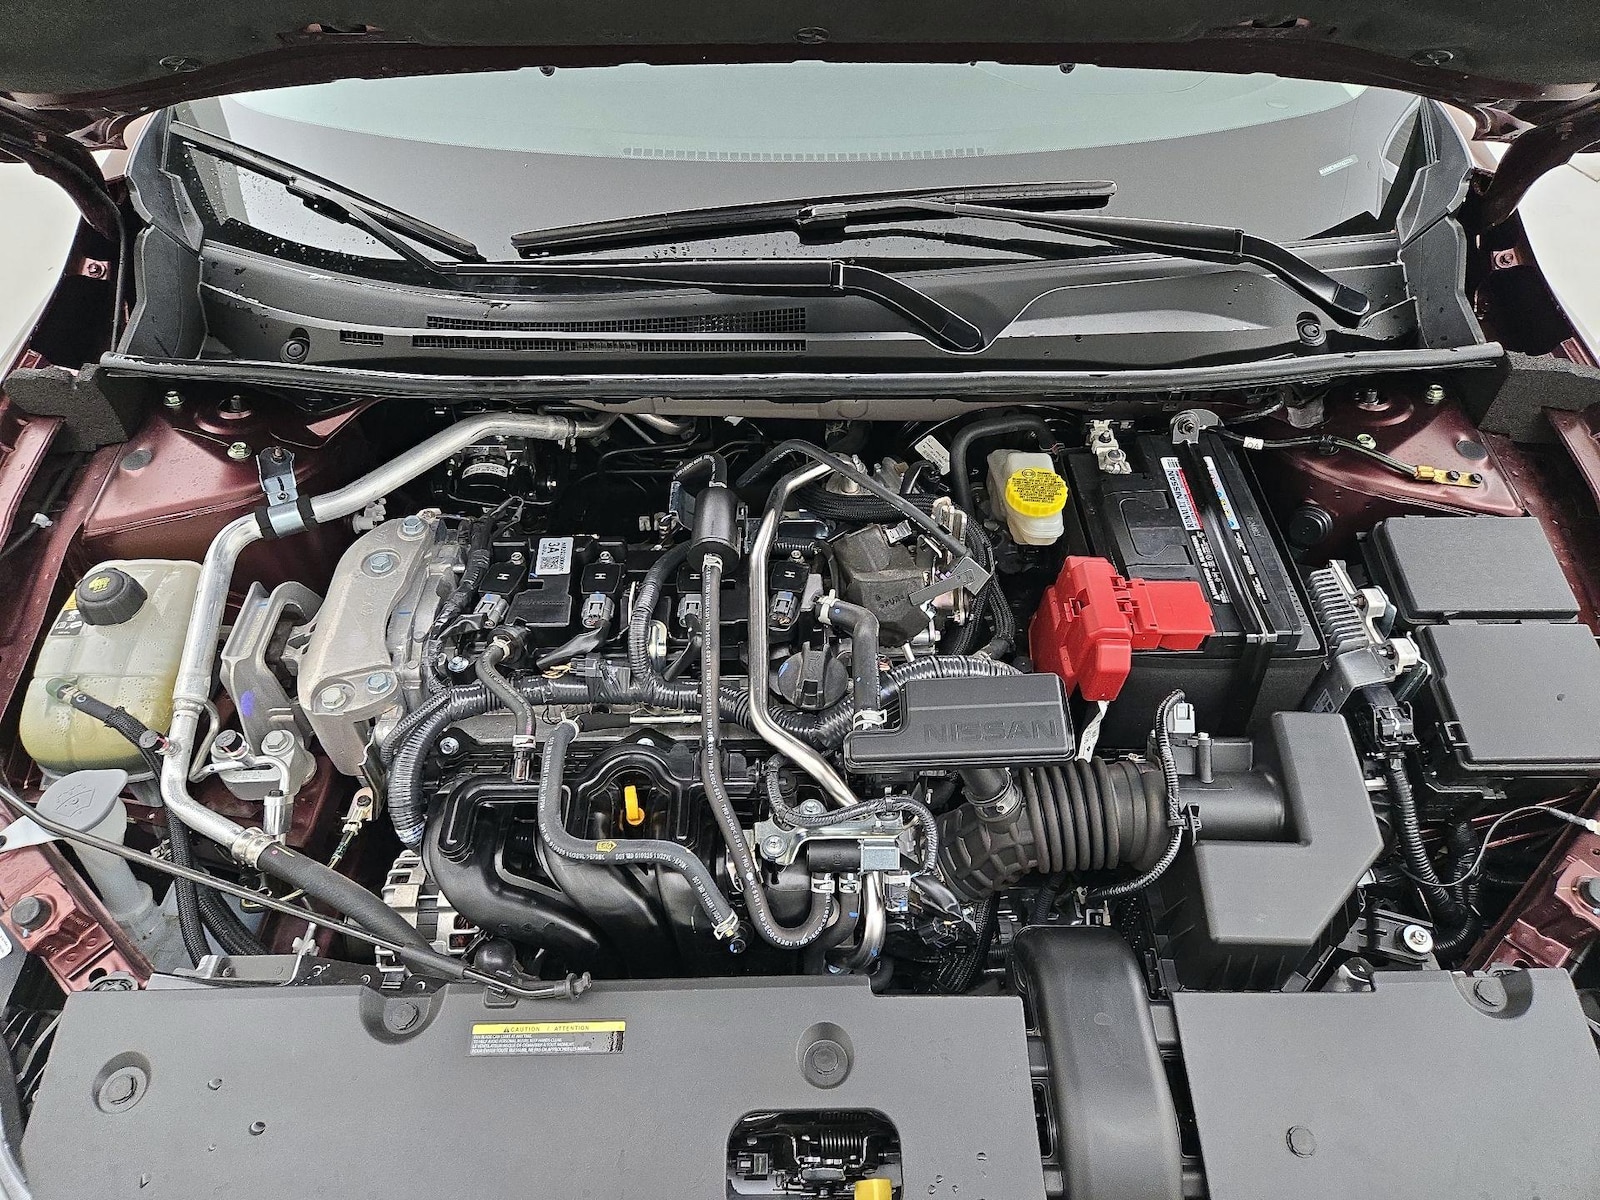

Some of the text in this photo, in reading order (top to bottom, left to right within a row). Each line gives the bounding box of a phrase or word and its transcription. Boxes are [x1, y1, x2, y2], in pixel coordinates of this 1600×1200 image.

[1167, 470, 1195, 529] RENAULT NISSAN
[547, 541, 561, 554] 3A
[922, 719, 1059, 744] NISSAN
